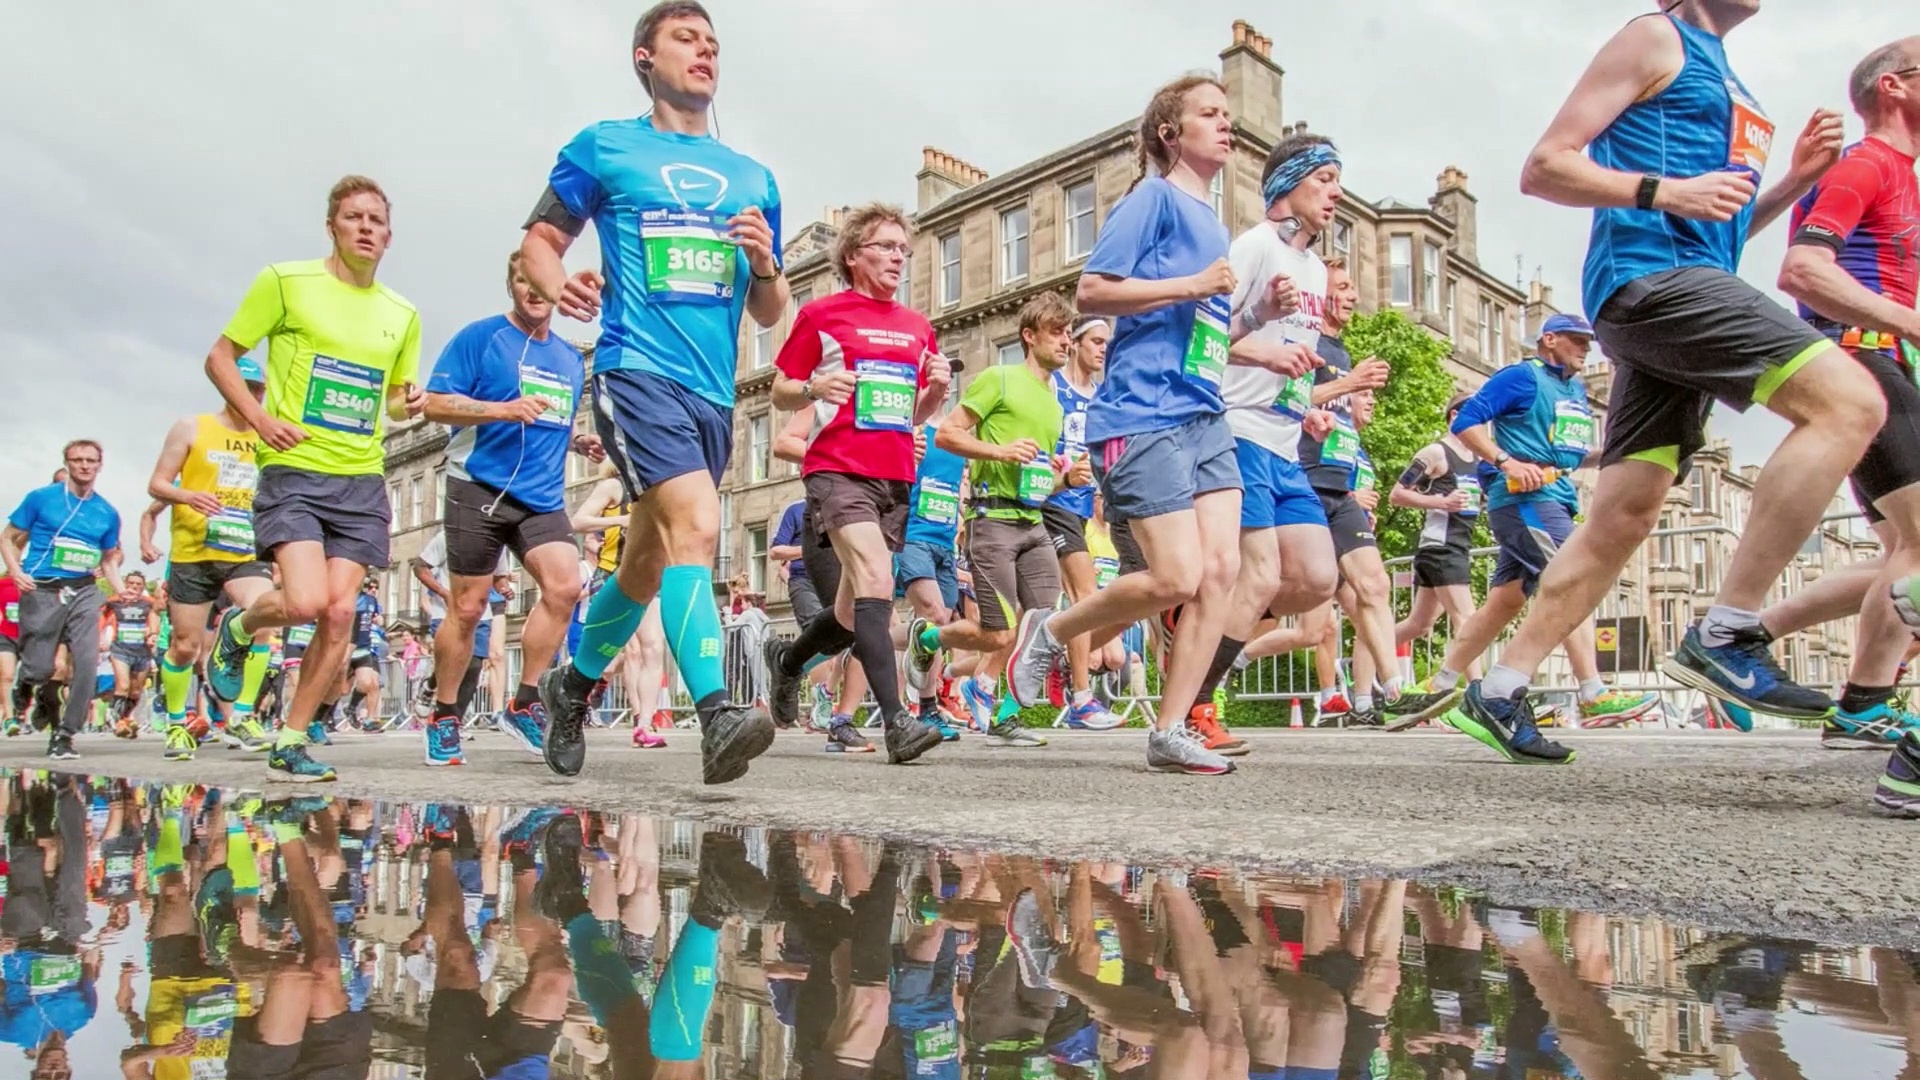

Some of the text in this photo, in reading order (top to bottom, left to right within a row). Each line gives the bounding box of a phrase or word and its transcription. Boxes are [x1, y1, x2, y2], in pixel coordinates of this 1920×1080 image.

[668, 213, 710, 222] marathon
[667, 247, 727, 273] 3165
[322, 388, 374, 413] 3540
[872, 390, 911, 410] 3382
[226, 439, 257, 453] IAN
